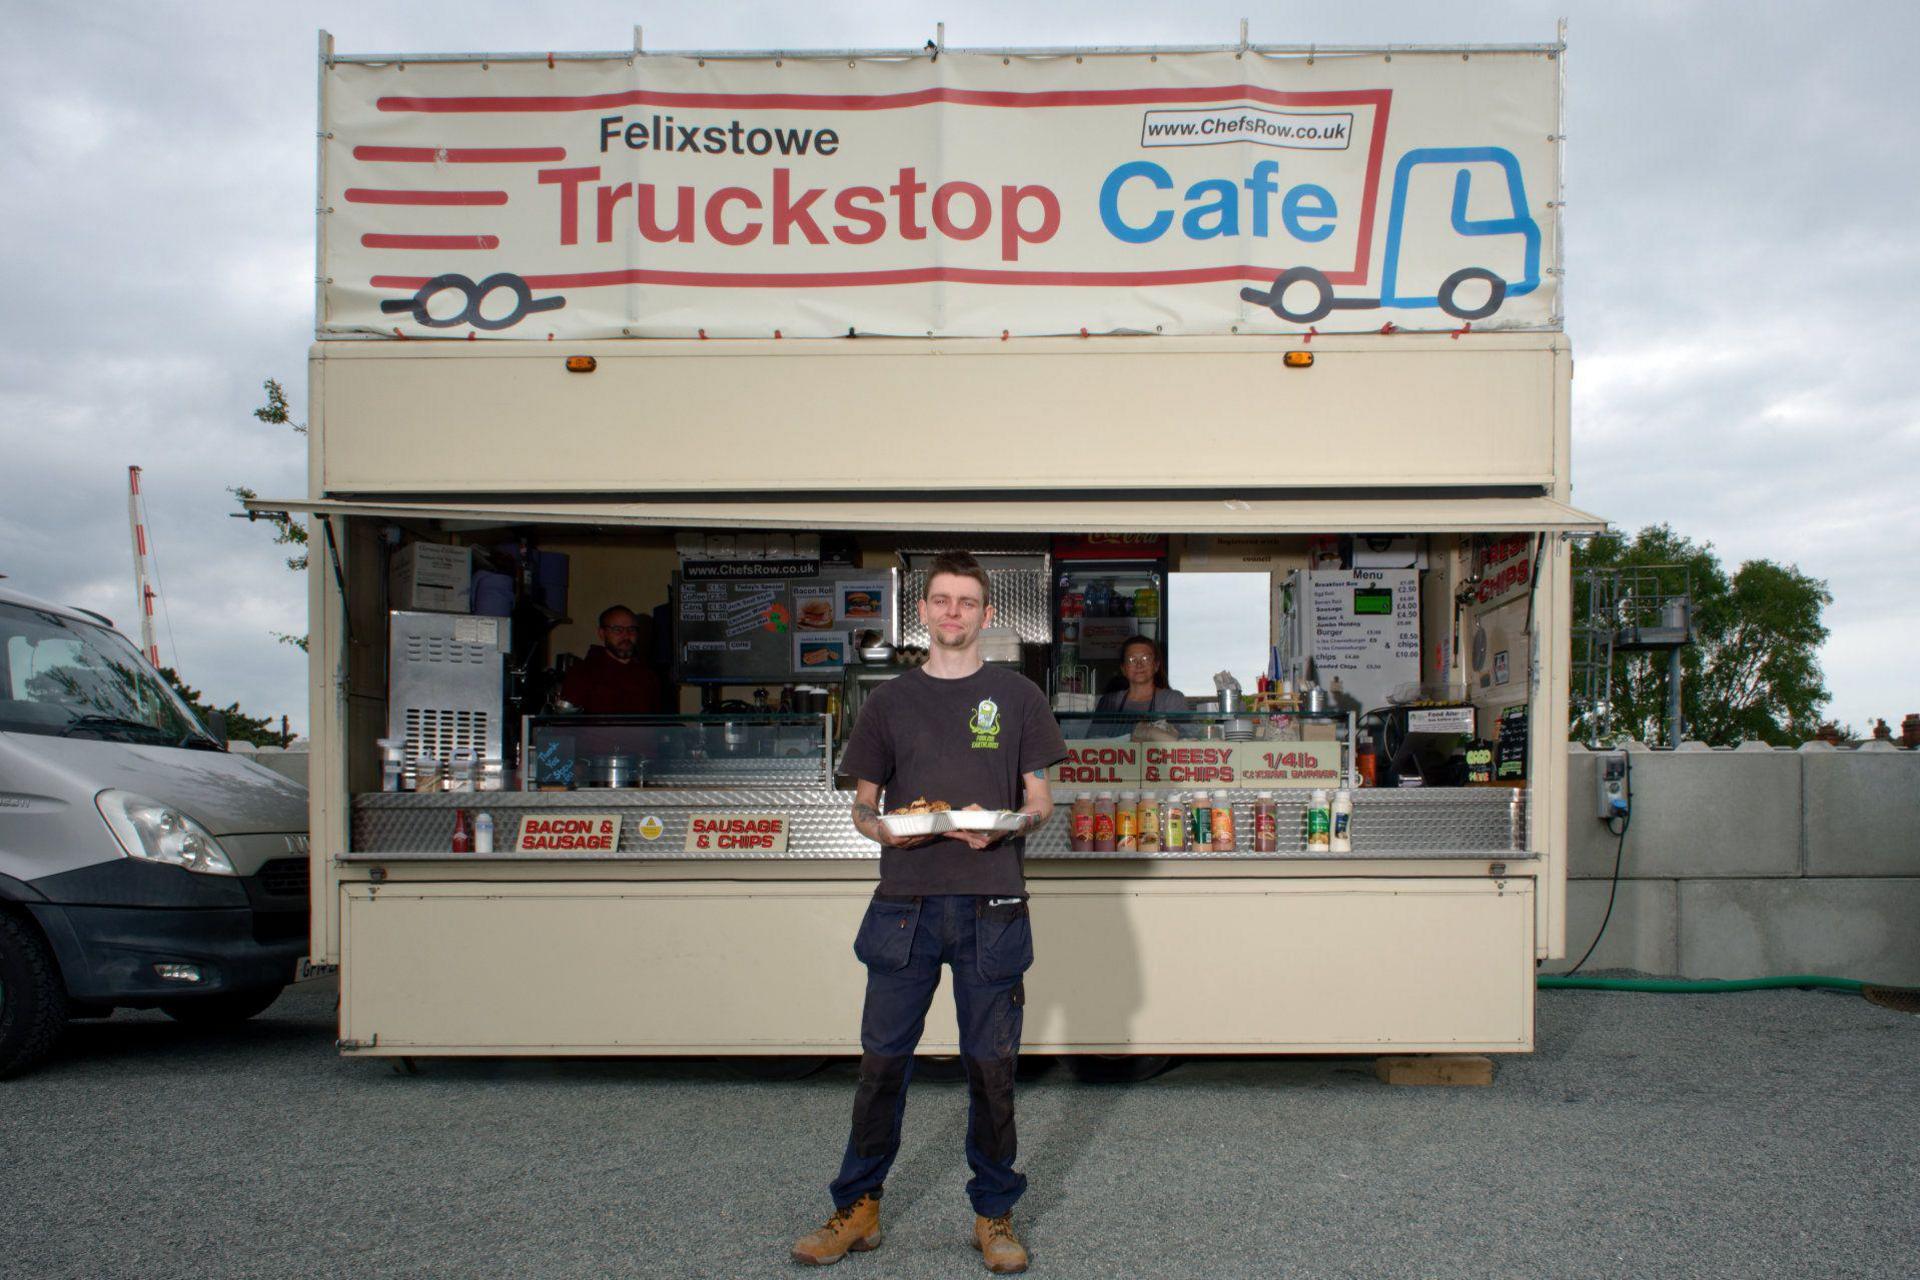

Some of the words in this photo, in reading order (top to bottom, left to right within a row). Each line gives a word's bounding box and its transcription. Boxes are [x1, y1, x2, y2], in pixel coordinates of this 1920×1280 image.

[600, 114, 839, 156] Felixstowe
[1147, 115, 1346, 142] www.ChefsRow.co.uk
[538, 166, 1061, 262] Truckstop
[1099, 160, 1338, 244] Cafe
[688, 563, 815, 576] www.ChefsRow.co.uk
[1353, 570, 1383, 580] Menu
[1477, 559, 1528, 603] CHIPS
[1060, 748, 1136, 766] ACON
[1146, 748, 1233, 764] CHEESY
[1262, 752, 1319, 769] 1/4lb
[1060, 767, 1123, 782] ROLL
[1145, 766, 1160, 782] &
[1170, 766, 1235, 782] CHIPS
[526, 820, 594, 834] BACON
[600, 820, 613, 833] &
[692, 820, 783, 833] SAUSAGE
[522, 836, 612, 849] SAUSAGE
[696, 835, 710, 848] &
[718, 836, 775, 848] CHIPS
